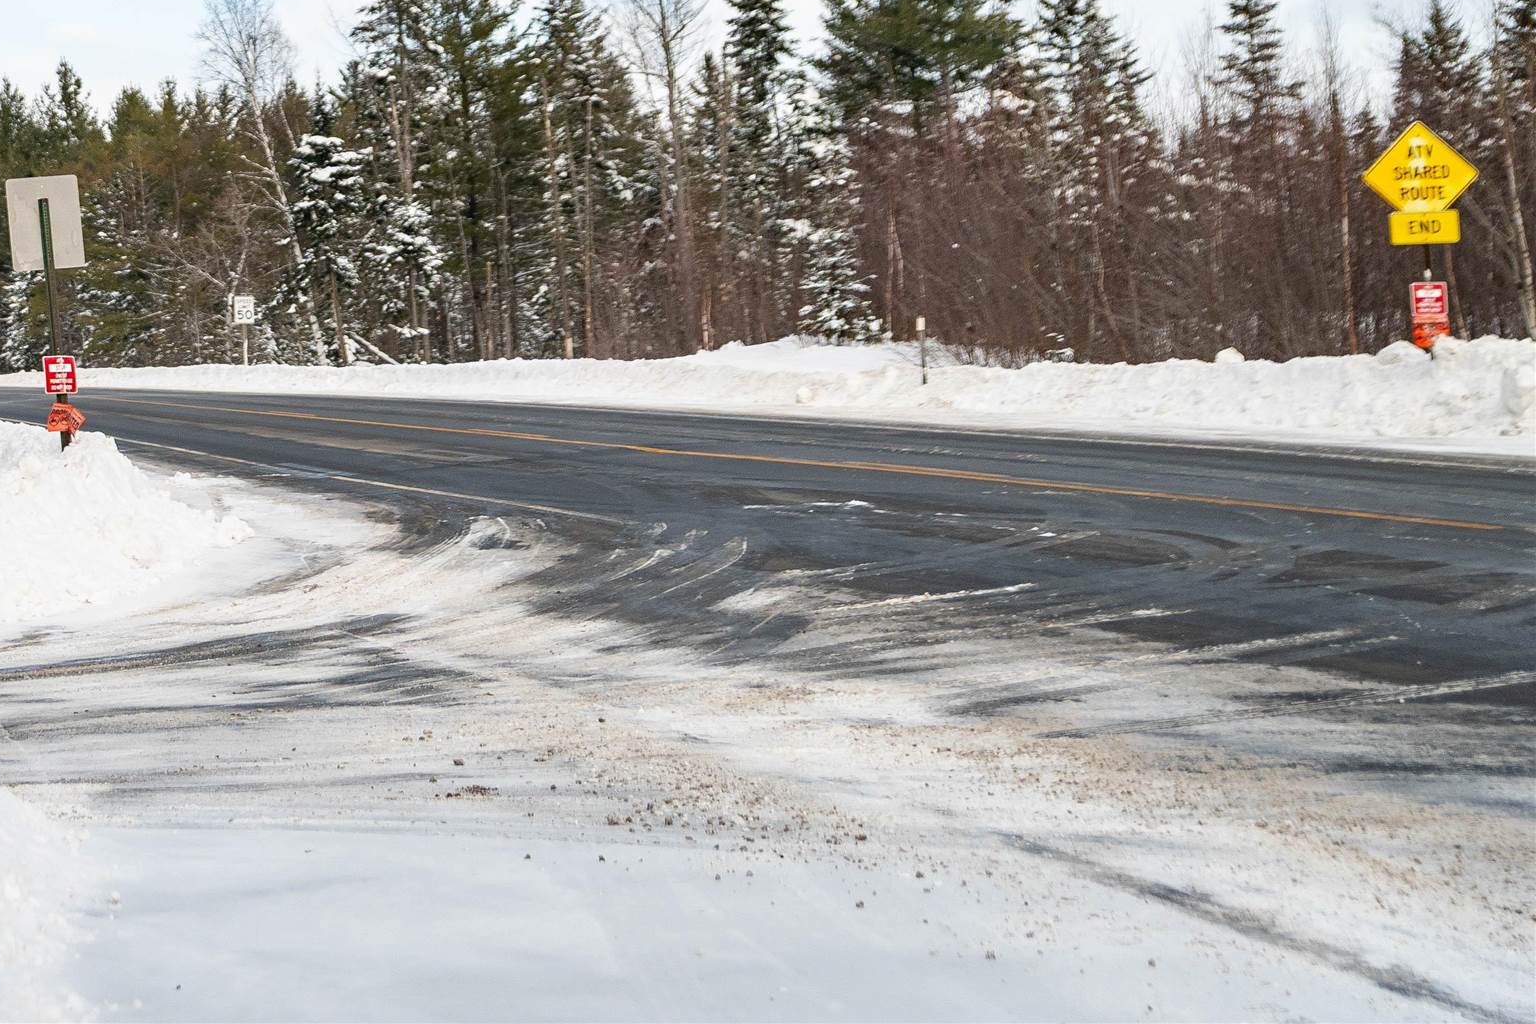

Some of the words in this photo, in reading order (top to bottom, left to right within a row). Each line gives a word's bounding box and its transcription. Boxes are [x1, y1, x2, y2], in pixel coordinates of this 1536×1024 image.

[1408, 144, 1433, 159] ATV
[1393, 165, 1450, 180] SHARED
[1400, 185, 1446, 200] ROUTE
[1408, 220, 1441, 234] END
[237, 309, 253, 320] 50
